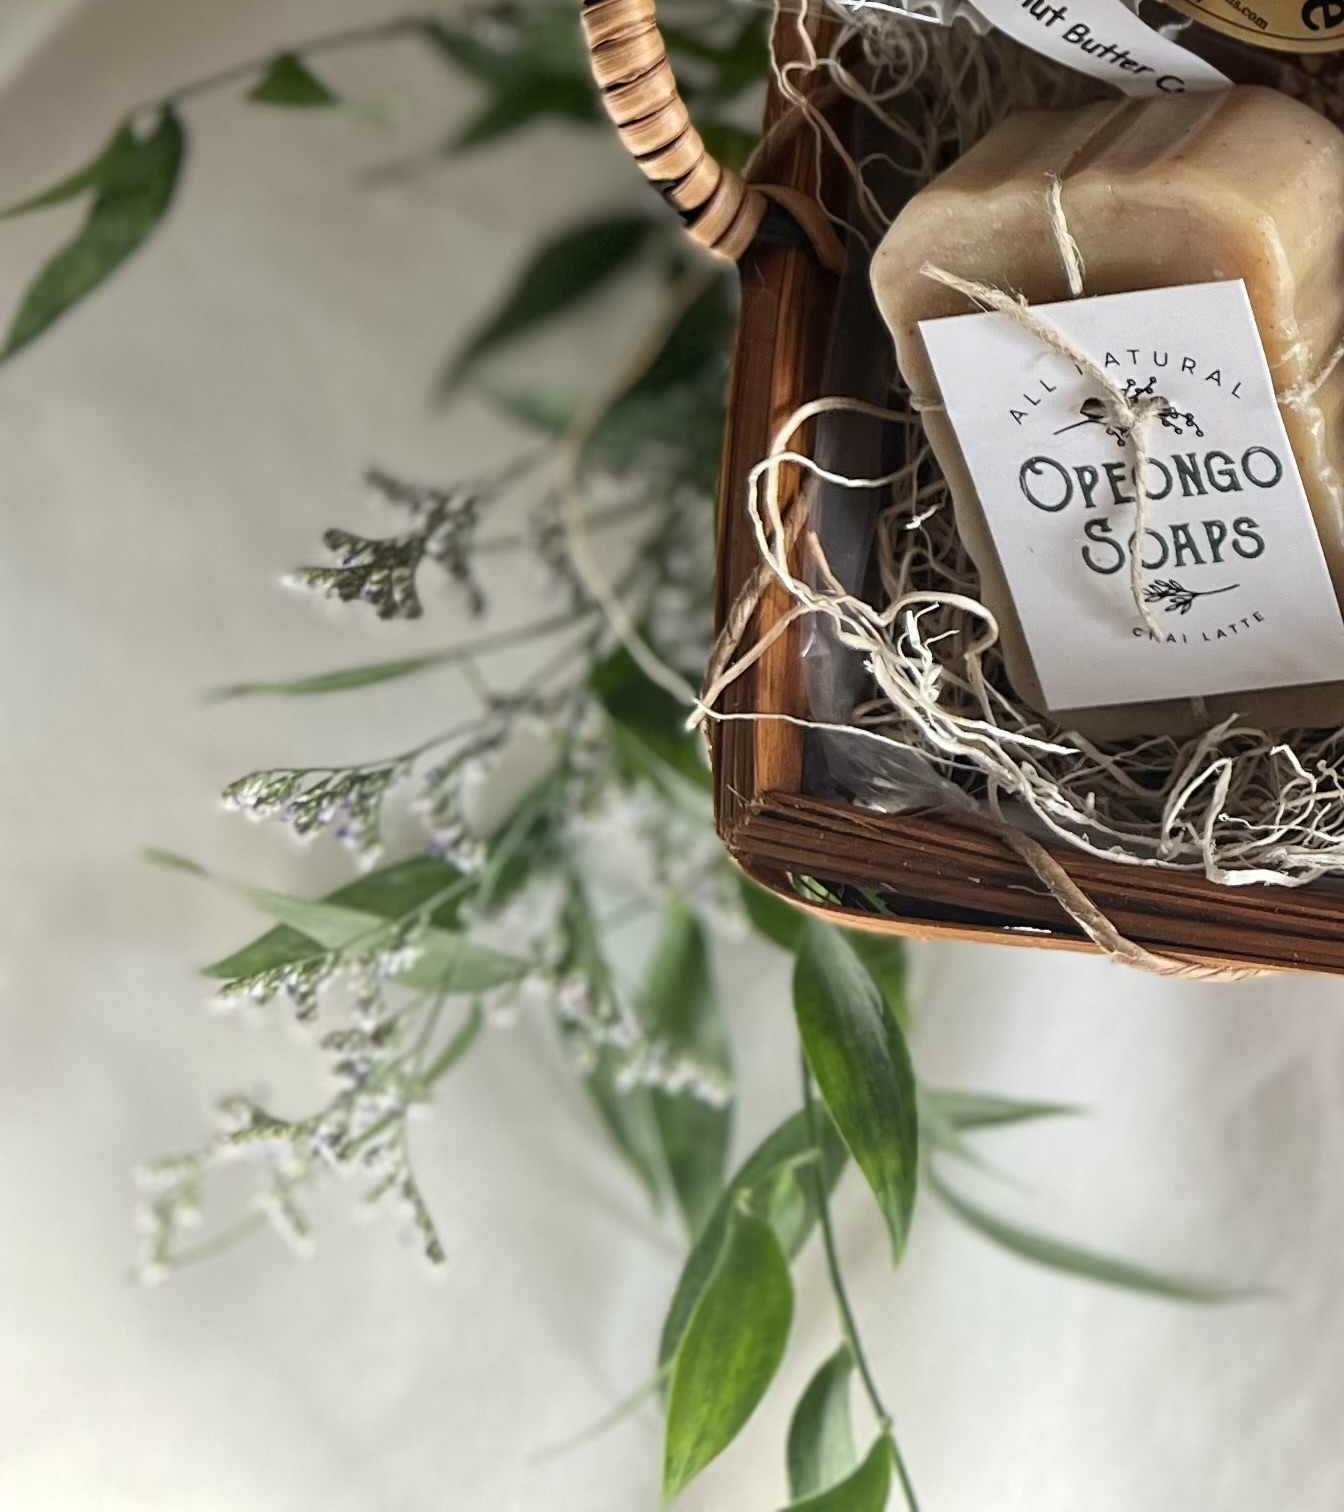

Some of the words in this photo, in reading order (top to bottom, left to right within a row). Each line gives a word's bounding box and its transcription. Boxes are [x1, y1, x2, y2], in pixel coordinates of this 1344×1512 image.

[1062, 22, 1155, 78] Butter
[1009, 379, 1057, 425] ALL
[1075, 349, 1243, 399] ATURAL
[1019, 445, 1283, 513] OPEONGO
[1081, 516, 1266, 576] SOAPS
[1202, 610, 1265, 643] LATTE
